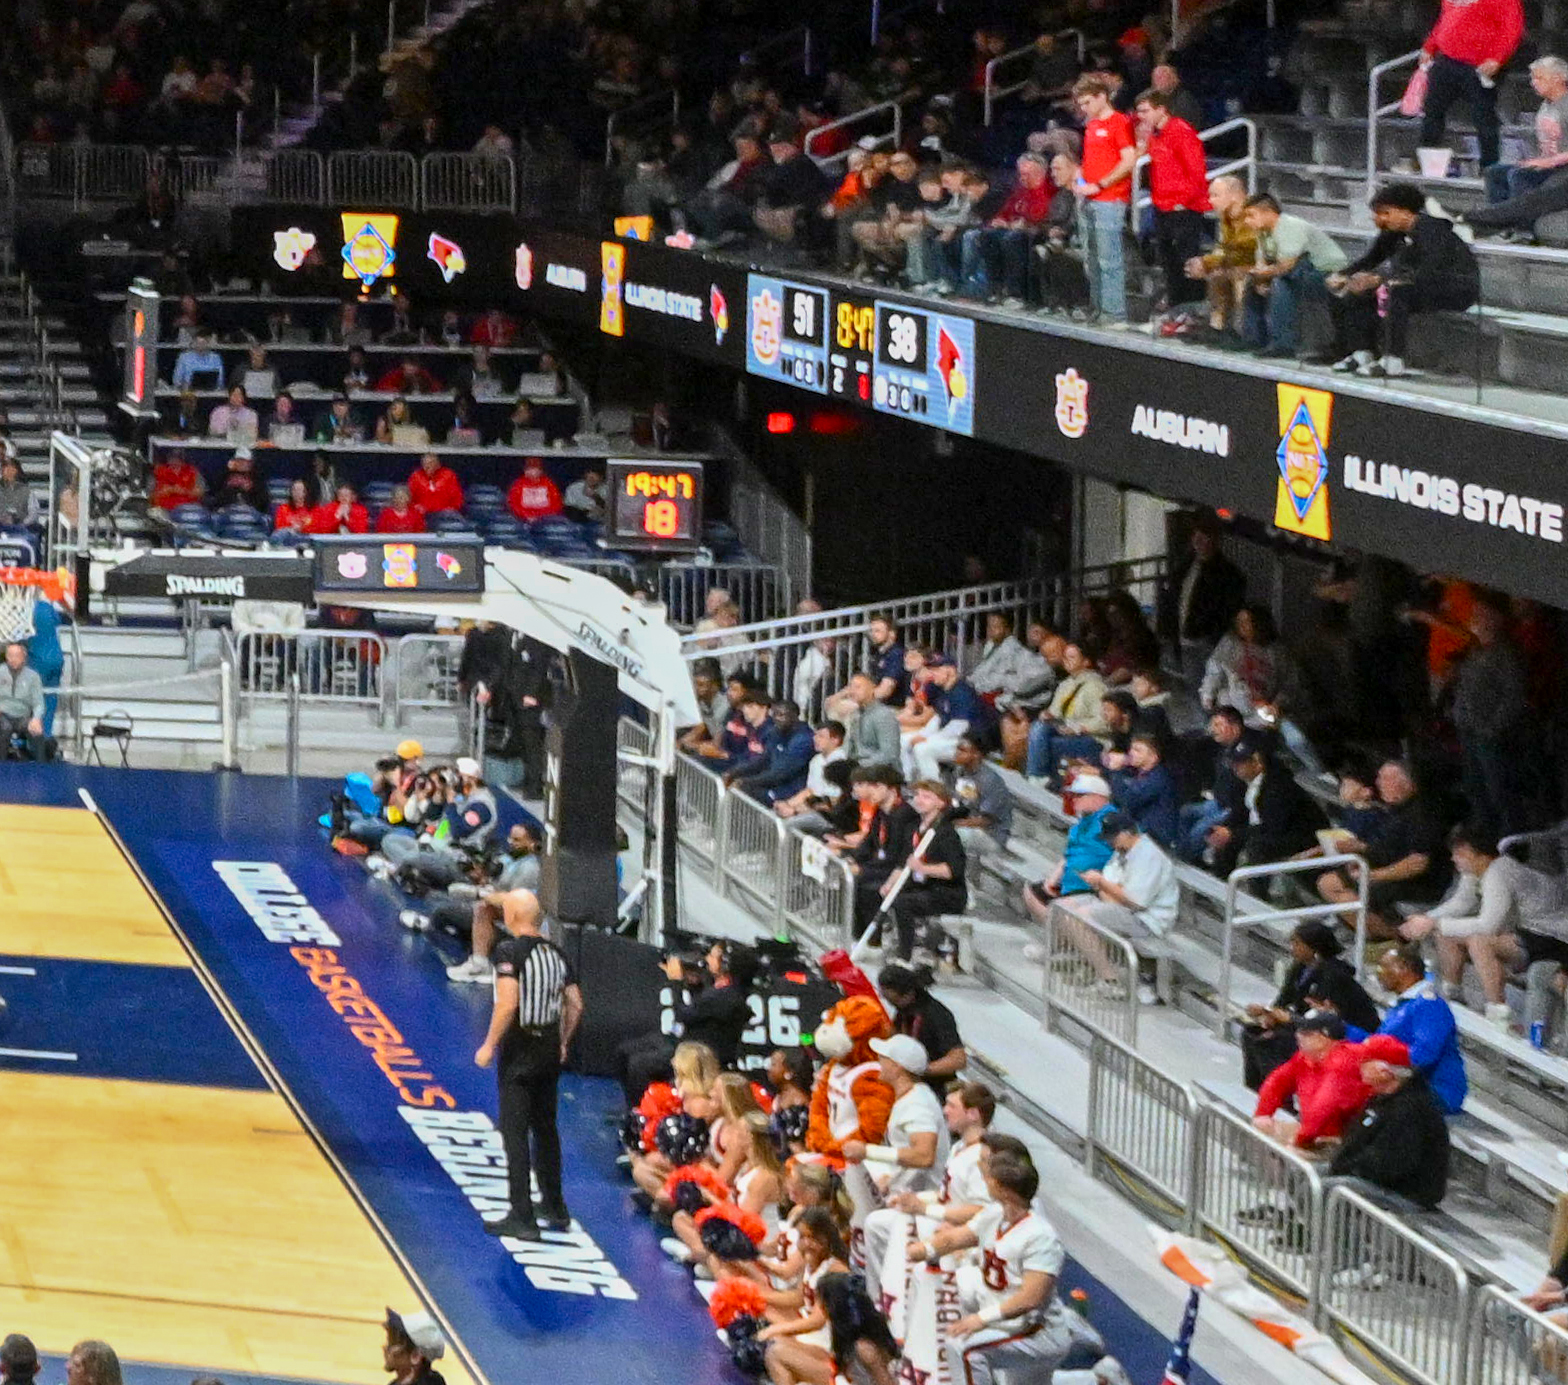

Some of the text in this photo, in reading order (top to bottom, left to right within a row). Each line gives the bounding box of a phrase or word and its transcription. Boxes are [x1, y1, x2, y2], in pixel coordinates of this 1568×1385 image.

[793, 292, 814, 337] 51
[888, 314, 917, 362] 38
[833, 367, 844, 393] 2
[1132, 405, 1229, 456] AUBURN
[626, 472, 694, 499] 19:47
[1344, 454, 1564, 541] ILLINOIS STATE
[644, 500, 678, 538] 18
[166, 575, 245, 597] SPALDING
[575, 621, 643, 680] SPALDING
[212, 861, 455, 1110] COLLEGE BASKETBALL'S
